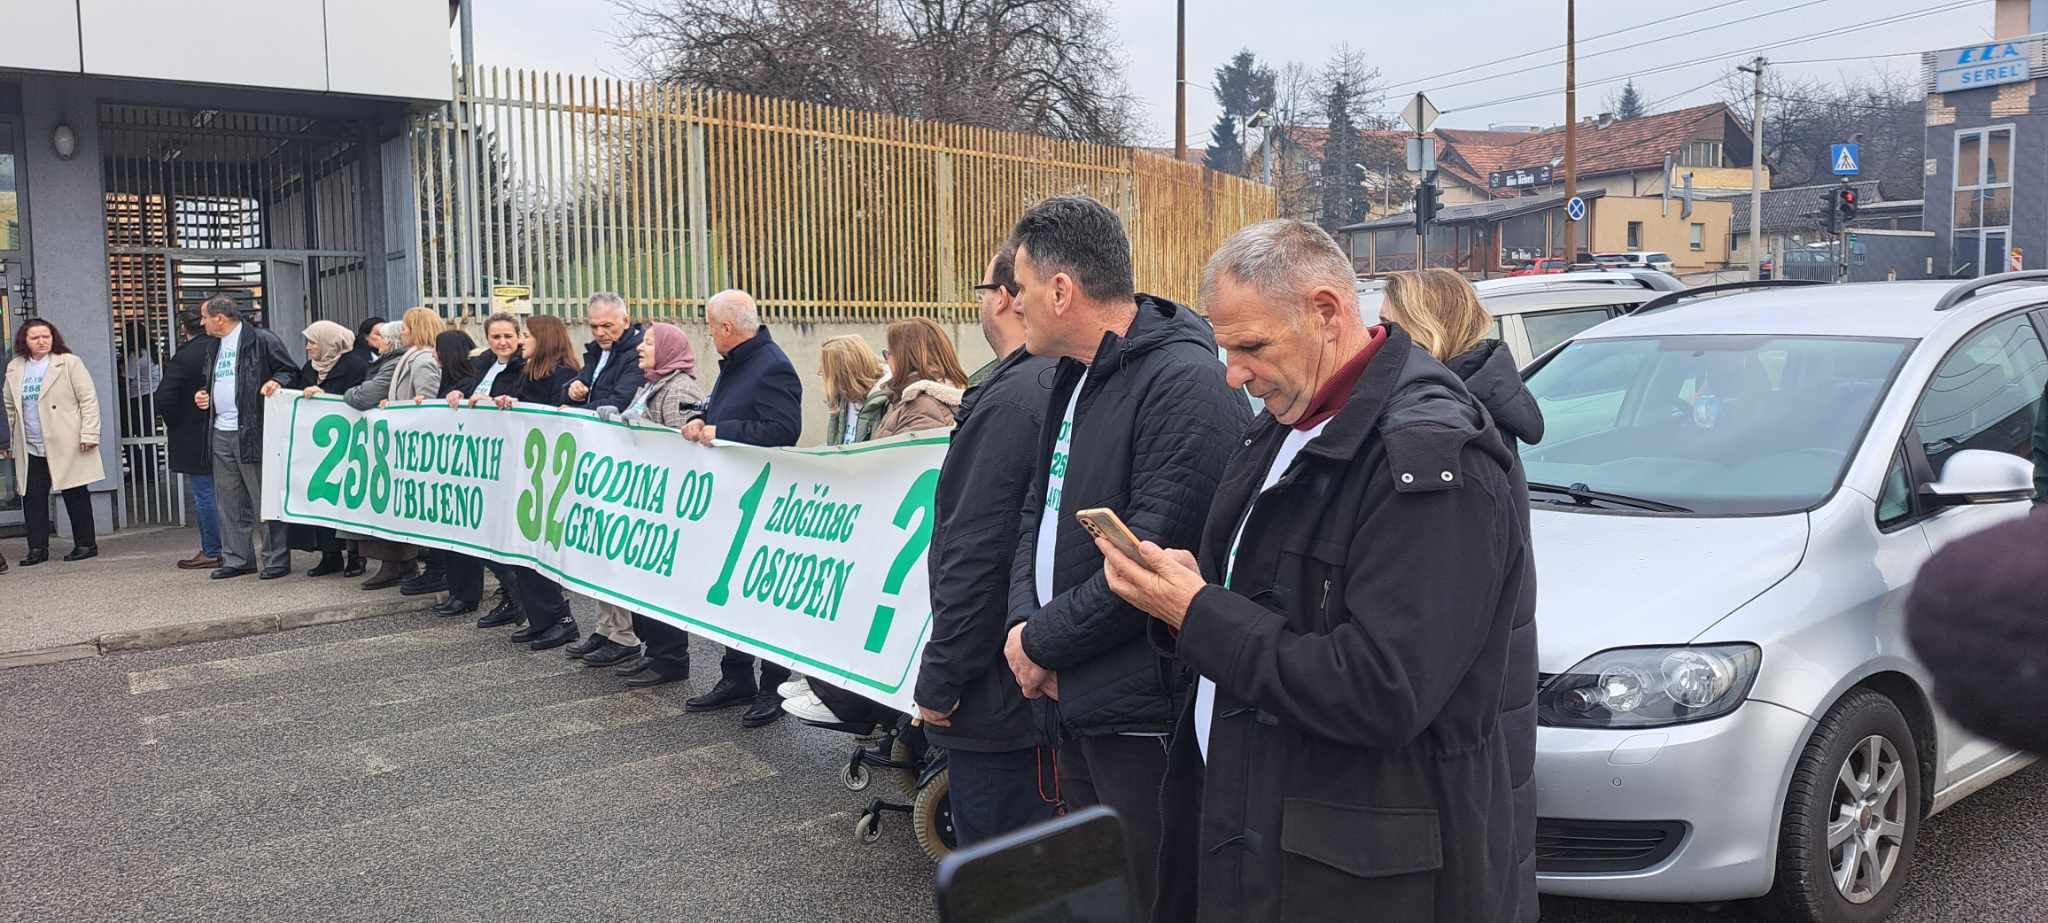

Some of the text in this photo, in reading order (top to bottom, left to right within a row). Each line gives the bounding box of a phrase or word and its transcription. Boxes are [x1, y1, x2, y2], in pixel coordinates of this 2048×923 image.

[1961, 64, 2019, 84] SEREL
[307, 414, 391, 515] 258
[394, 422, 504, 481] NEDUŽNIH
[575, 451, 714, 522] GODINA OD
[393, 478, 484, 530] UBIJENO
[516, 427, 577, 552] 32
[764, 482, 862, 543] zločinac
[564, 502, 681, 577] GENOCIDA
[706, 461, 771, 607] 1
